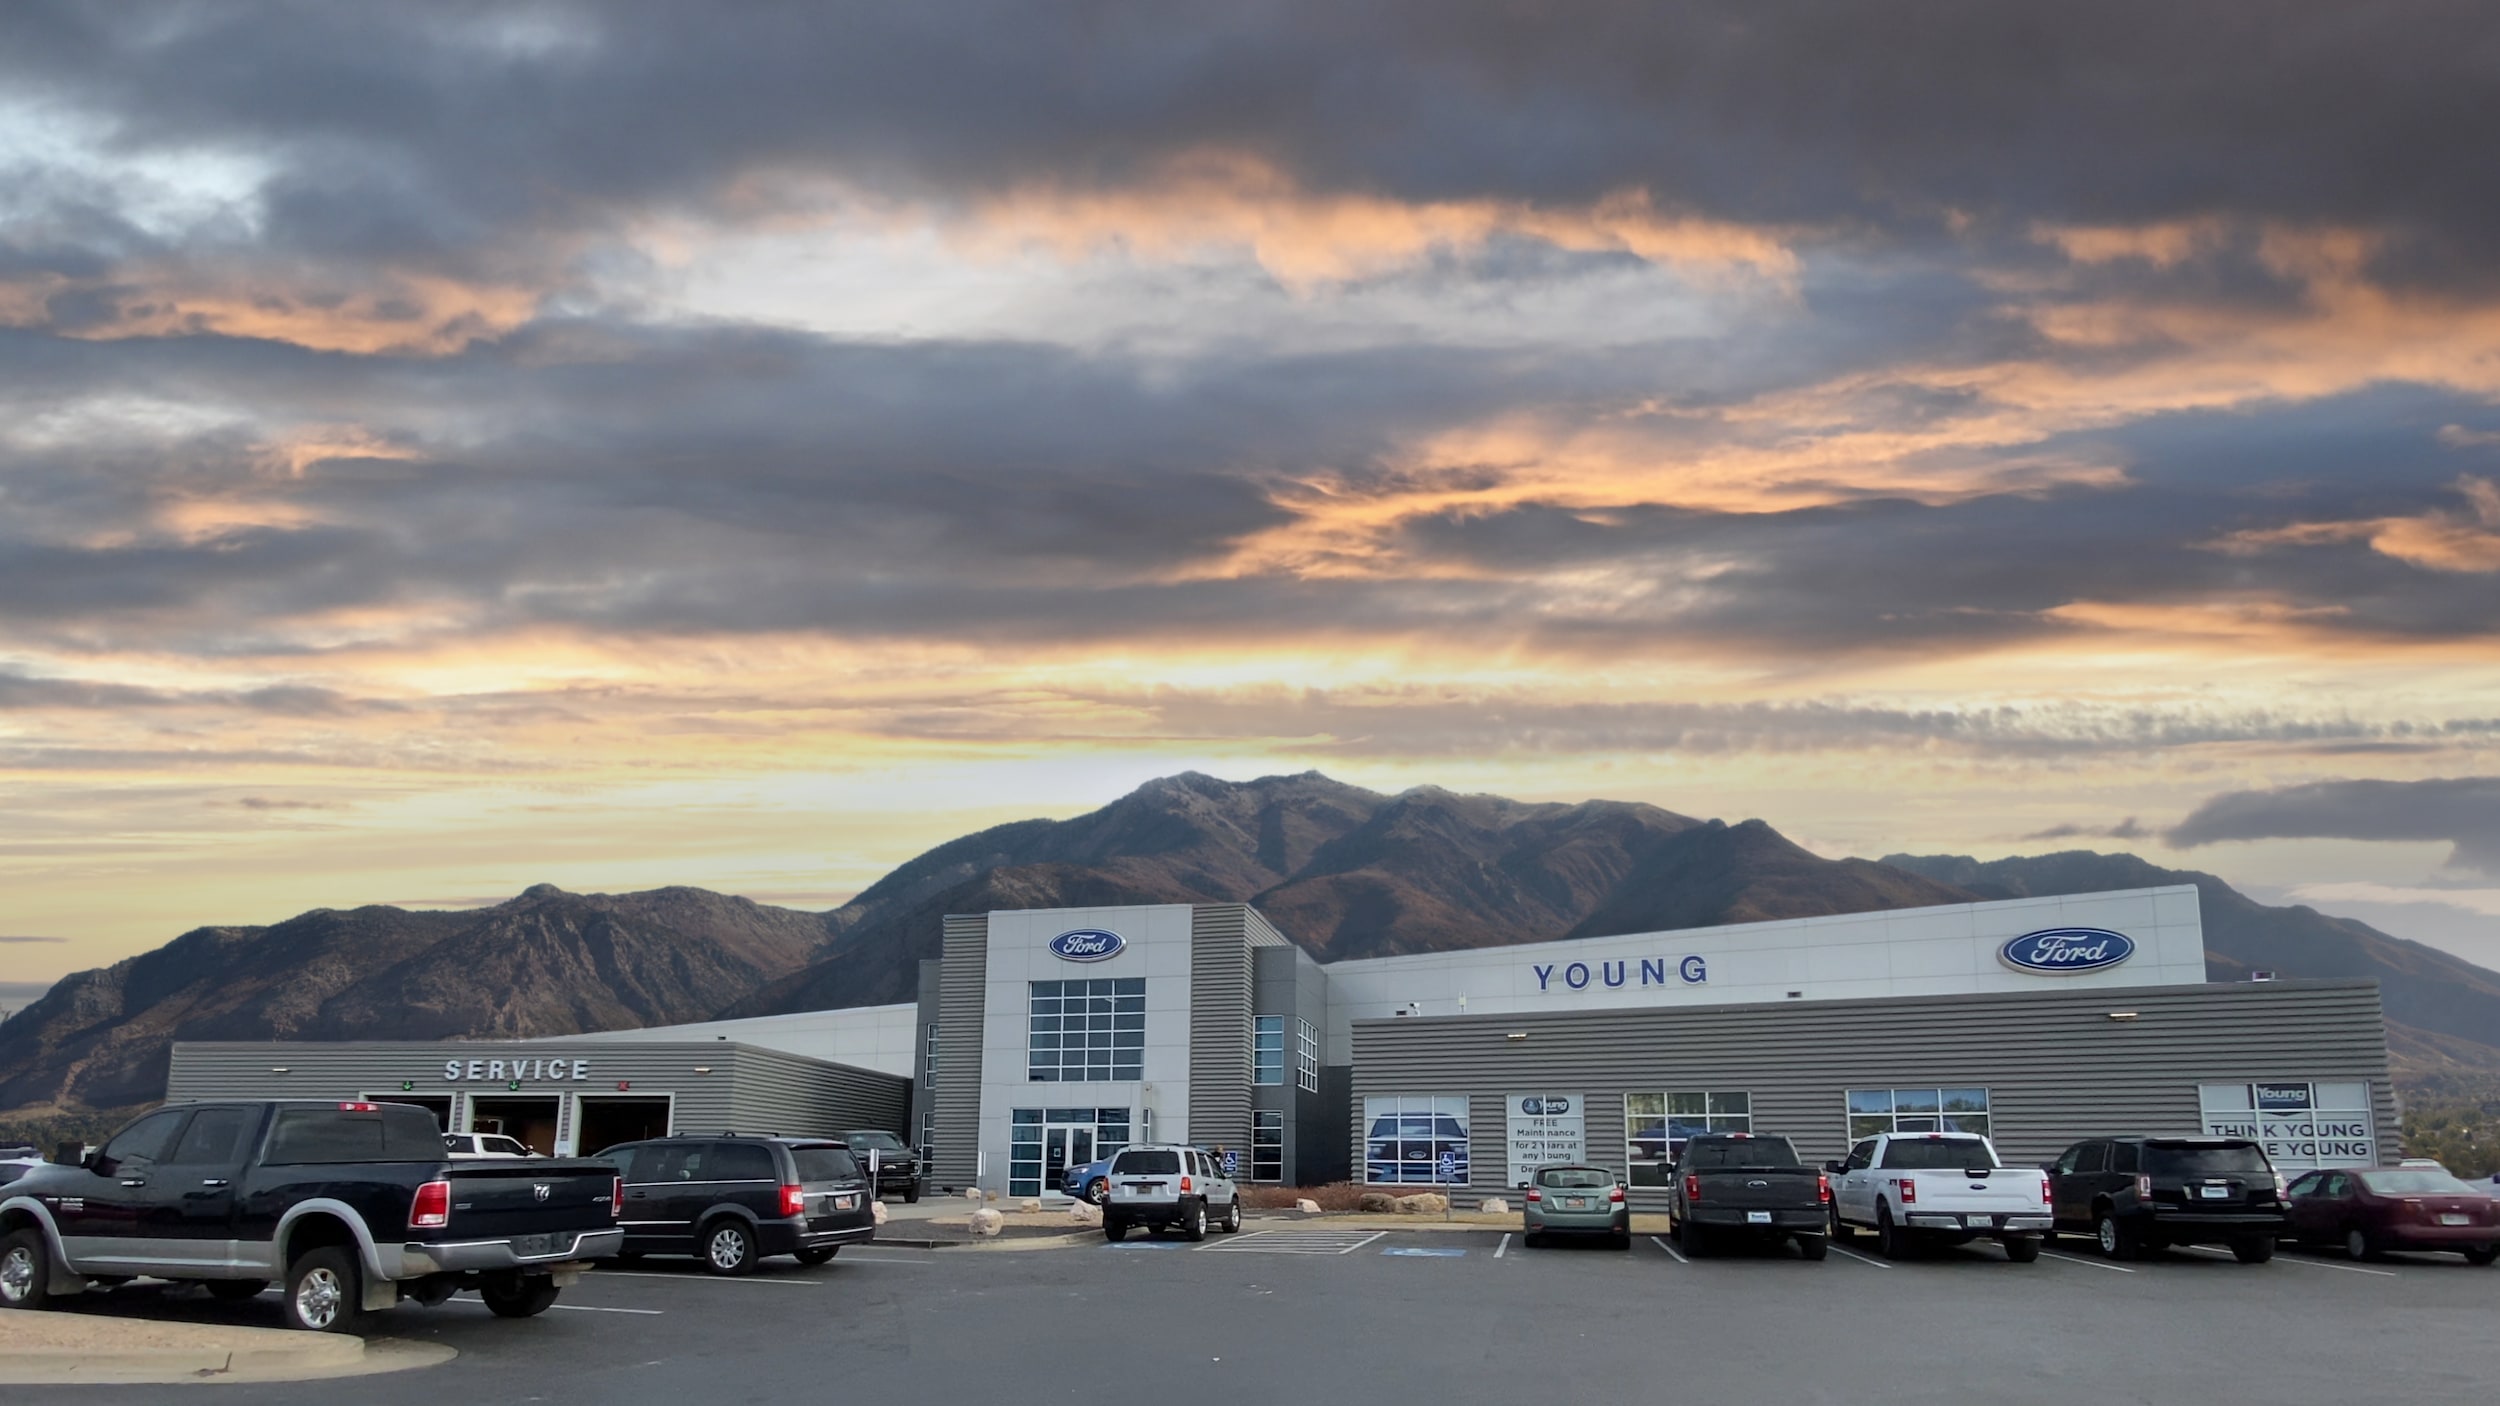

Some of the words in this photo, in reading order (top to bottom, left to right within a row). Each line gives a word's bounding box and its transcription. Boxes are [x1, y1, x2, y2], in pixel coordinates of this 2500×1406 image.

[1063, 934, 1107, 953] Ford
[2030, 935, 2109, 964] Ford
[1532, 955, 1707, 991] YOUNG
[444, 1059, 588, 1080] SERVICE
[2257, 1087, 2307, 1101] Young
[1538, 1100, 1568, 1111] Yung
[1533, 1119, 1558, 1127] FREE
[2210, 1124, 2278, 1137] THINK
[2284, 1124, 2365, 1137] YOUNG
[1516, 1142, 1529, 1150] for
[1531, 1142, 1537, 1150] 2
[1567, 1142, 1577, 1150] at
[2287, 1142, 2367, 1156] YOUNG
